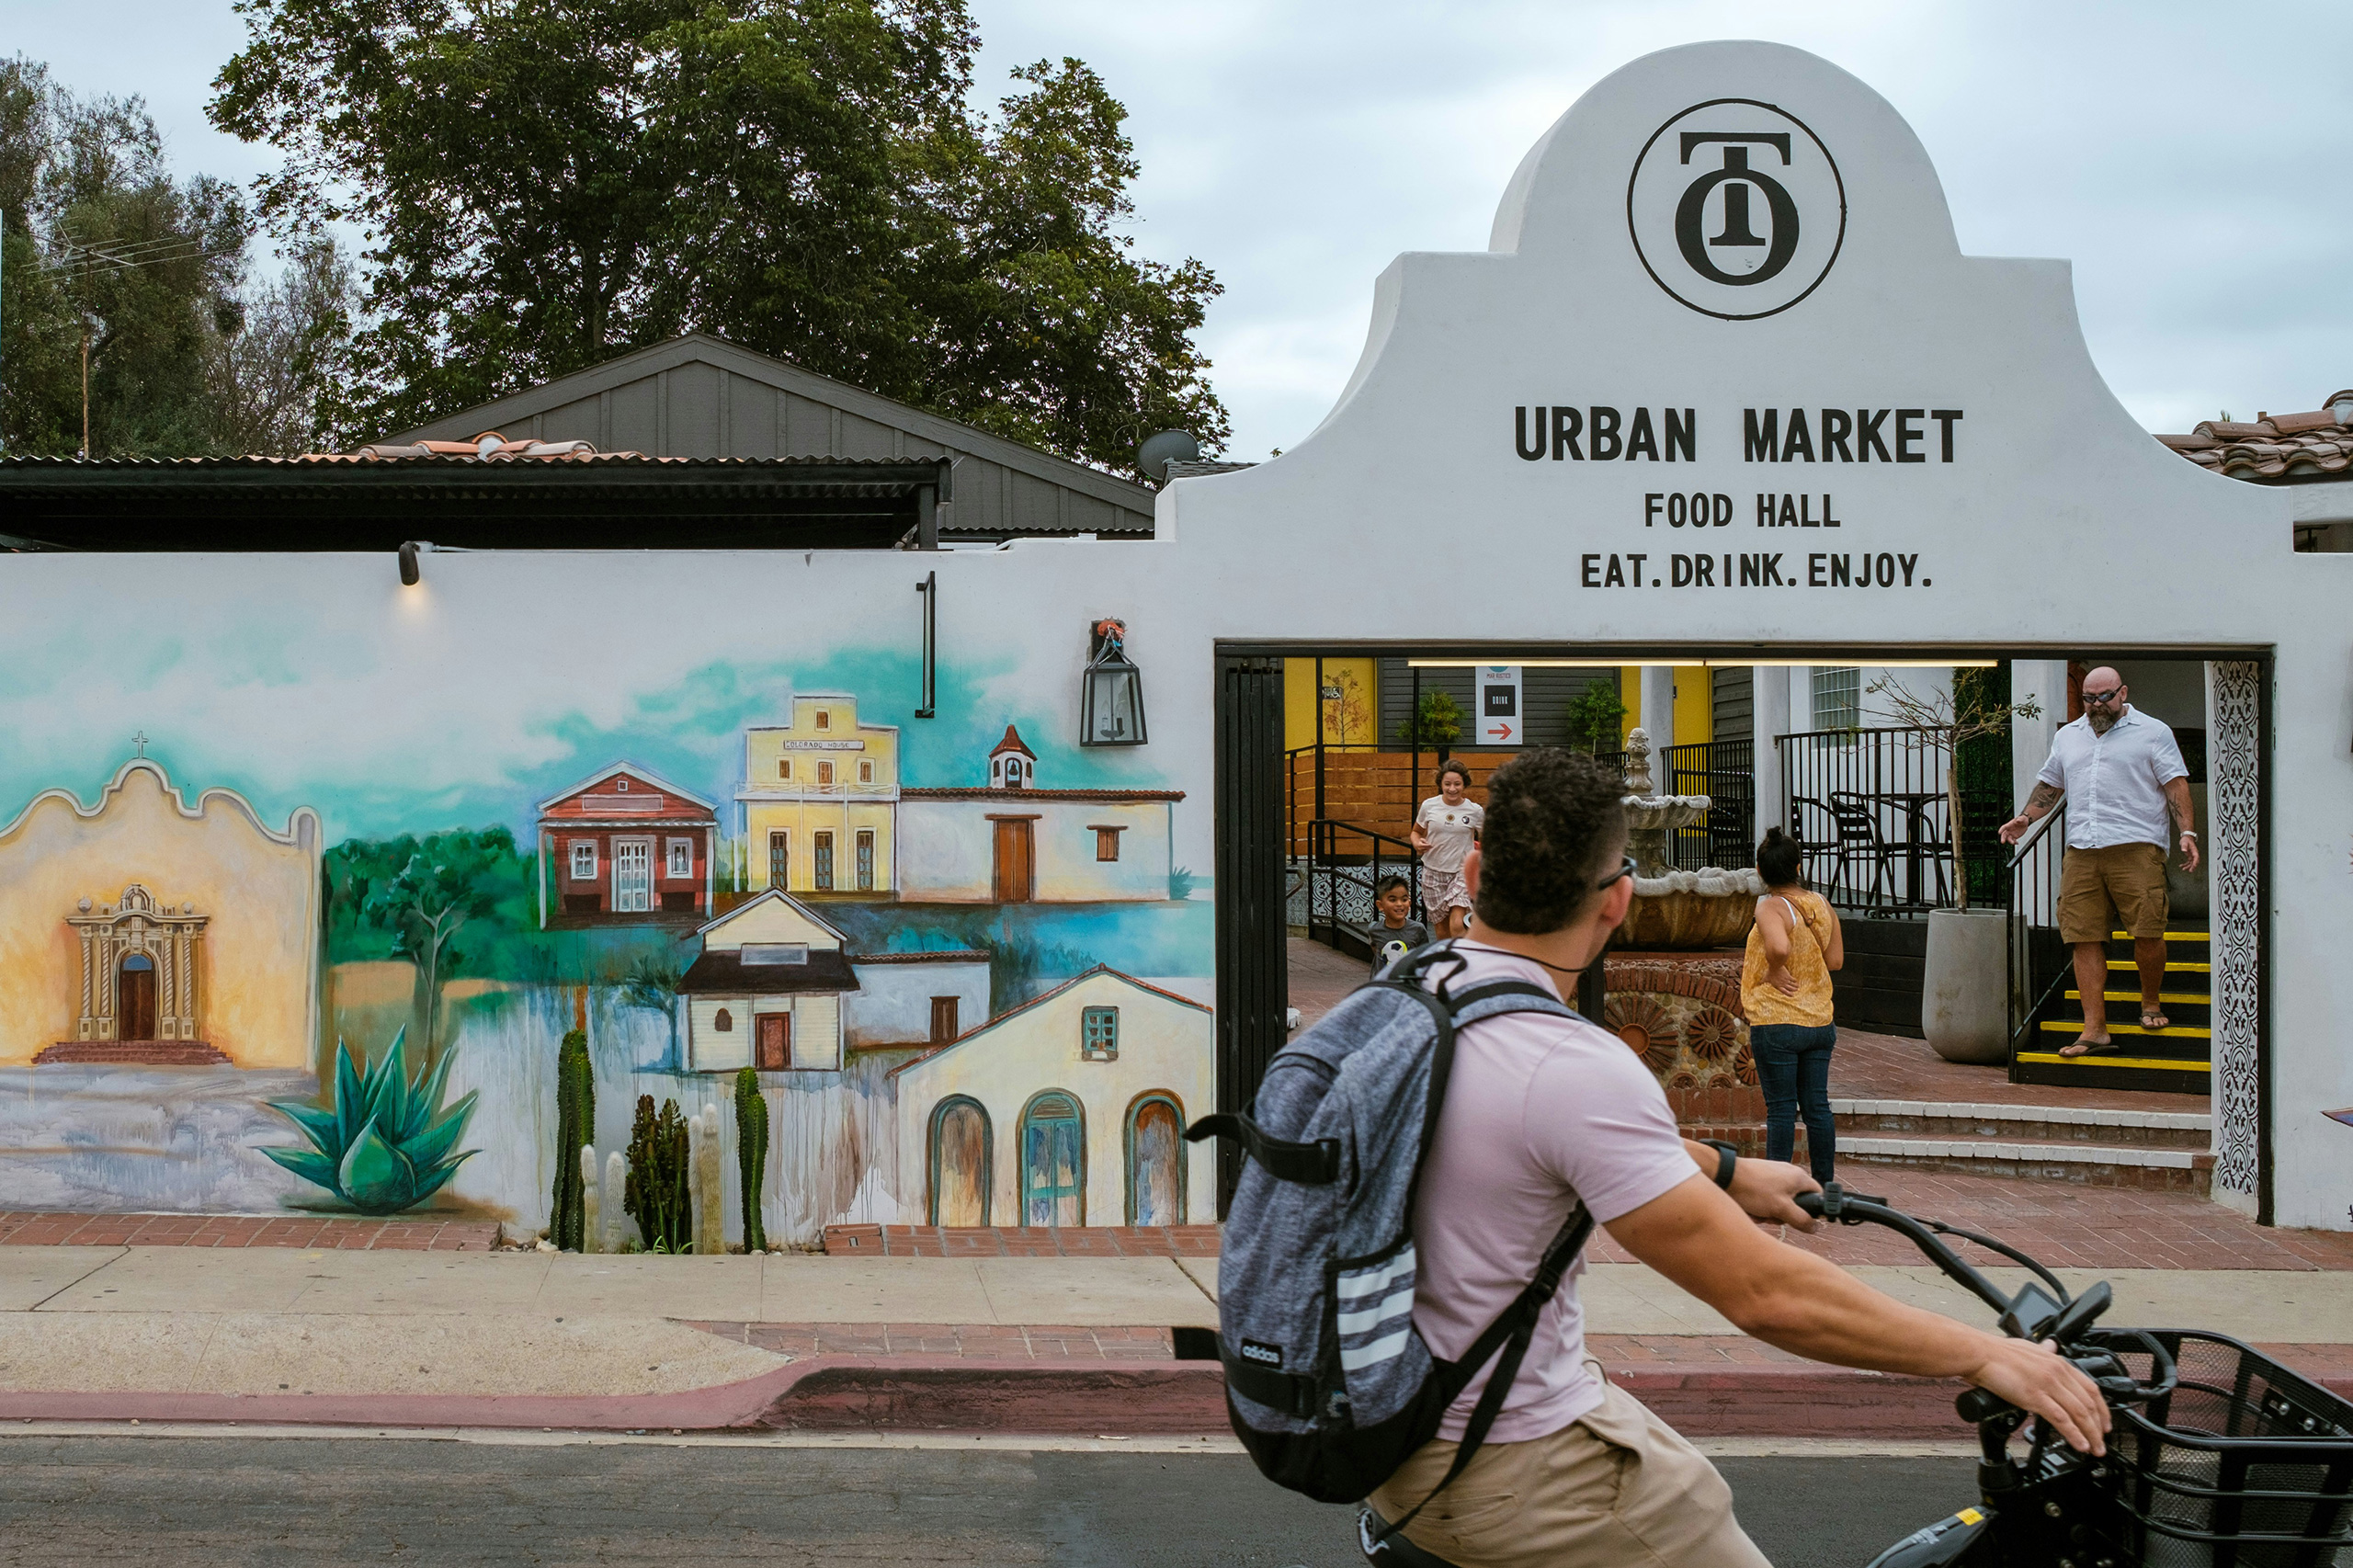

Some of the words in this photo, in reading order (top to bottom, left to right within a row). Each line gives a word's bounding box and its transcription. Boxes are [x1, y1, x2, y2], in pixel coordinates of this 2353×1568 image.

[1515, 405, 1696, 462] URBAN
[1744, 407, 1963, 463] MARKET
[1644, 492, 1733, 528] FOOD
[1756, 493, 1841, 528] HALL
[786, 740, 823, 749] COLORADO
[1242, 1346, 1279, 1363] adidas
